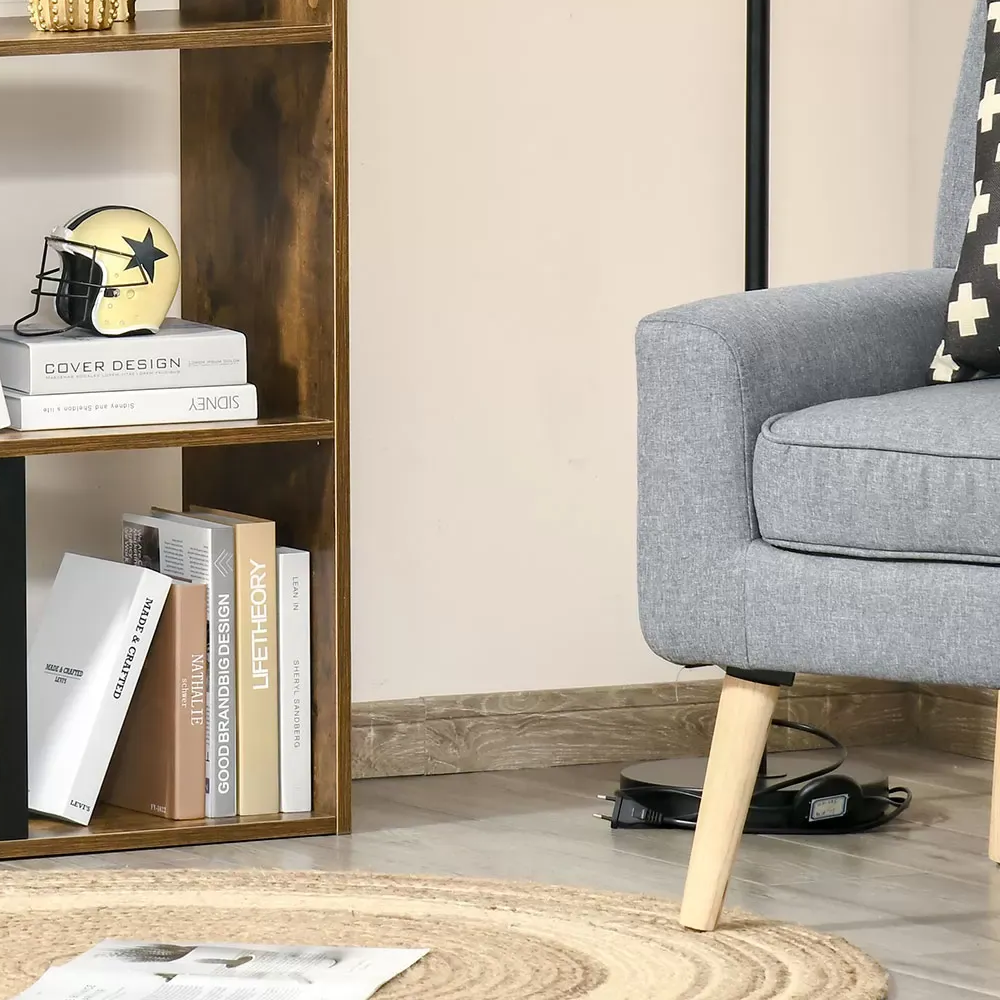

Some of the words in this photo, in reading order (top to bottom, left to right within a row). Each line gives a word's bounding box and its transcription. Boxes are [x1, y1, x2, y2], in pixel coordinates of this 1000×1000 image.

[45, 361, 105, 375] COVER
[112, 357, 182, 372] DESIGN
[63, 404, 92, 412] Sheldon
[94, 403, 108, 411] and
[110, 402, 135, 410] Sidney
[188, 394, 241, 412] SIDNEY
[292, 576, 300, 598] LEAN
[135, 597, 154, 634] MADE
[292, 602, 300, 611] IN
[217, 593, 230, 656] DESIGN
[250, 558, 269, 690] LIFETHEORY
[131, 634, 141, 644] &
[112, 645, 137, 700] CRAFTED
[292, 659, 300, 696] SHERYL
[293, 698, 301, 748] SANDBERG
[217, 745, 230, 794] GOOD
